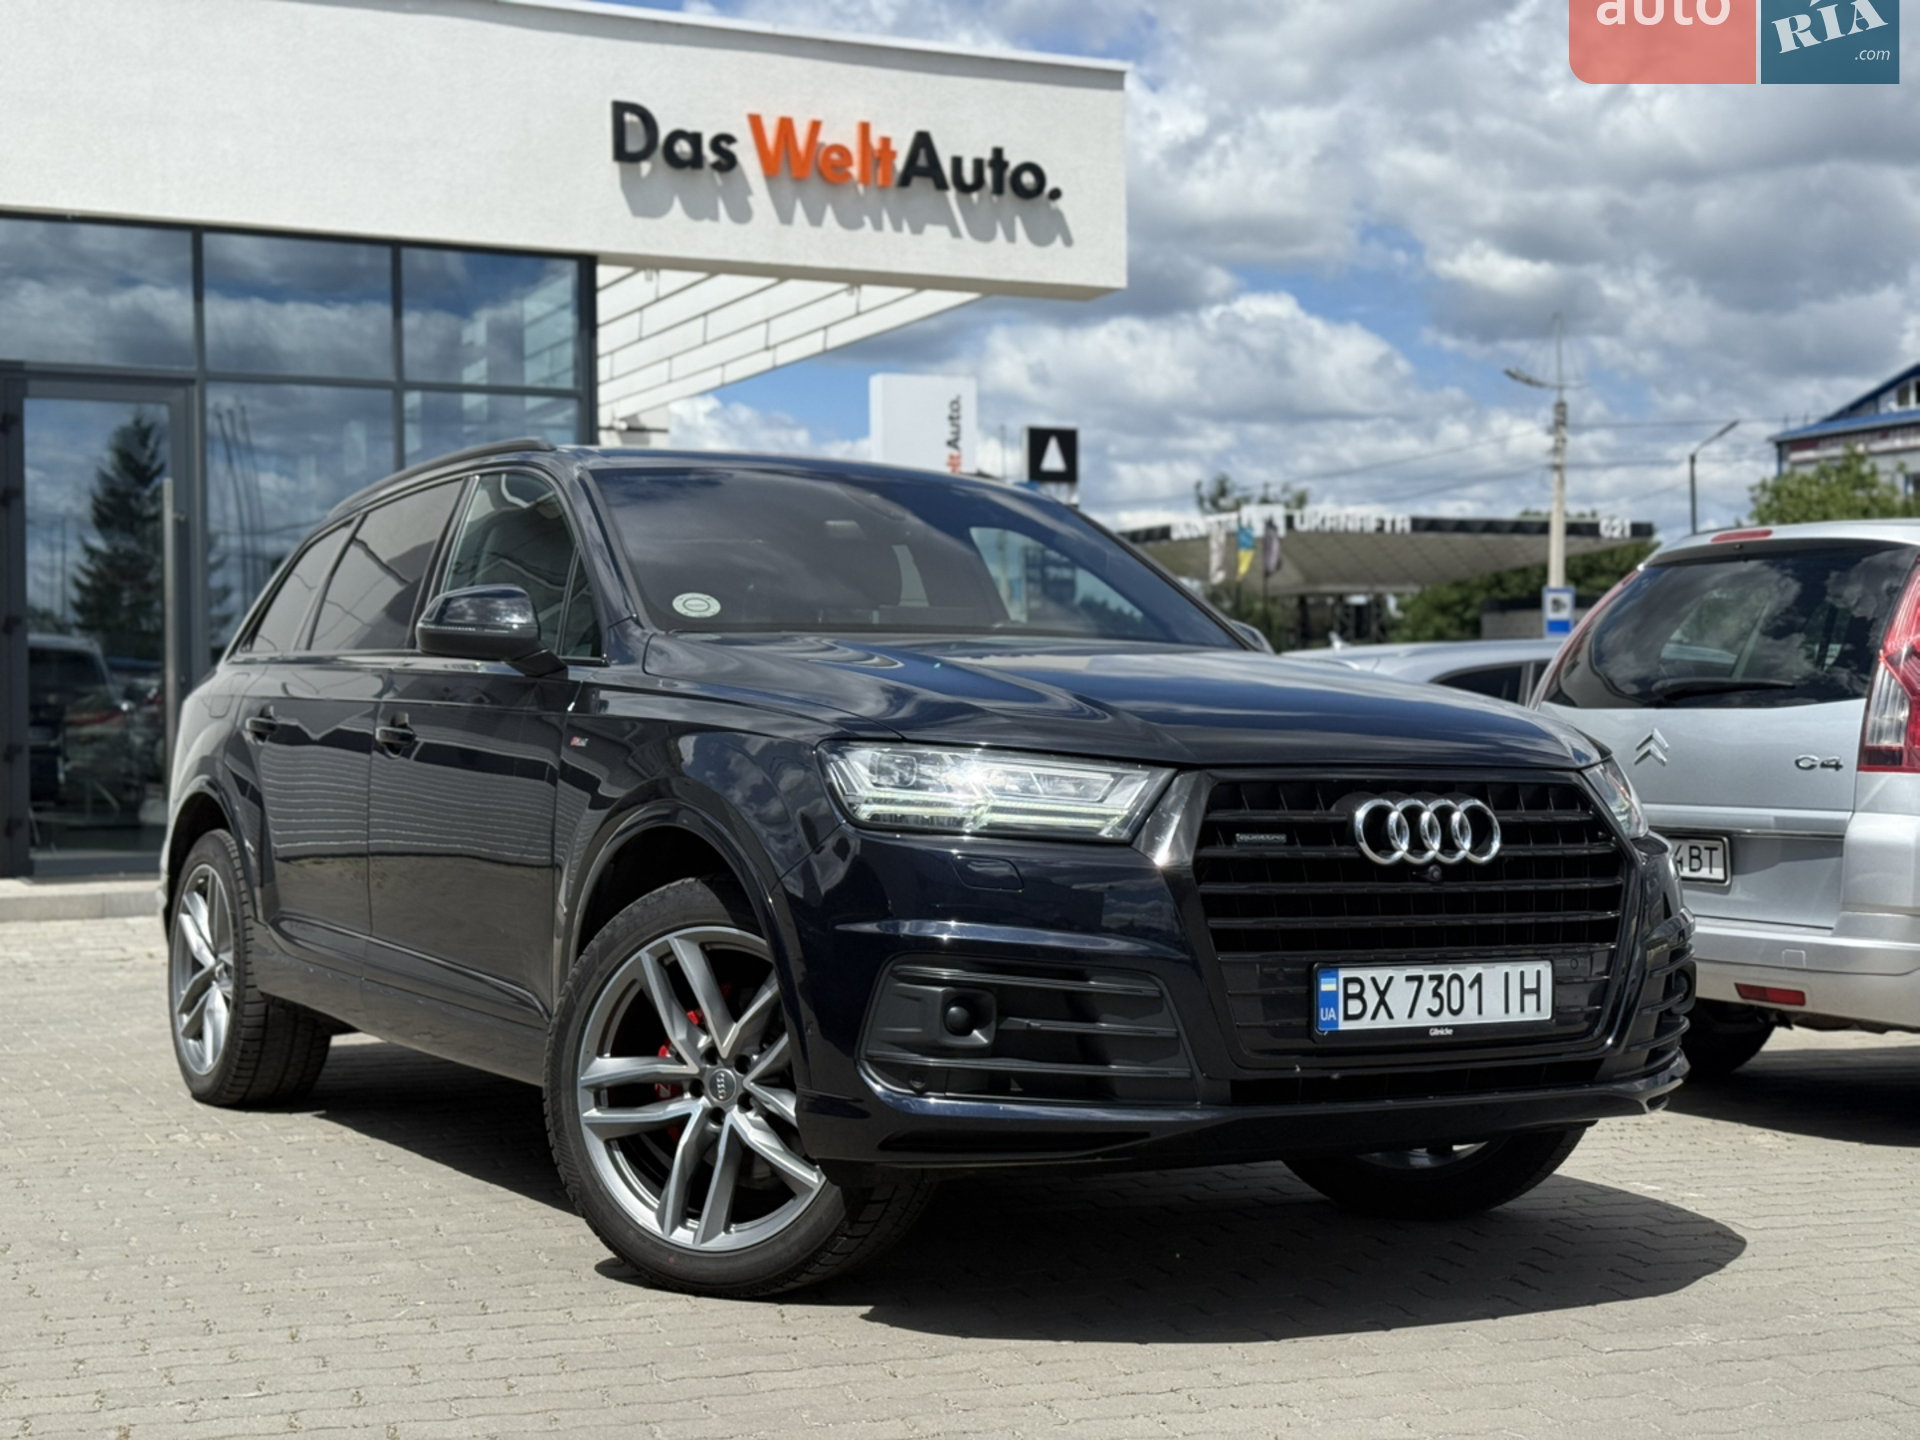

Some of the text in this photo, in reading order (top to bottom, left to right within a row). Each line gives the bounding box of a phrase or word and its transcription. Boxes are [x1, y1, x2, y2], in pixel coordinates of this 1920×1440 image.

[612, 100, 738, 173] Das
[1795, 755, 1843, 771] C4
[1342, 969, 1541, 1021] BX 7301 IH
[1320, 1007, 1337, 1021] UA
